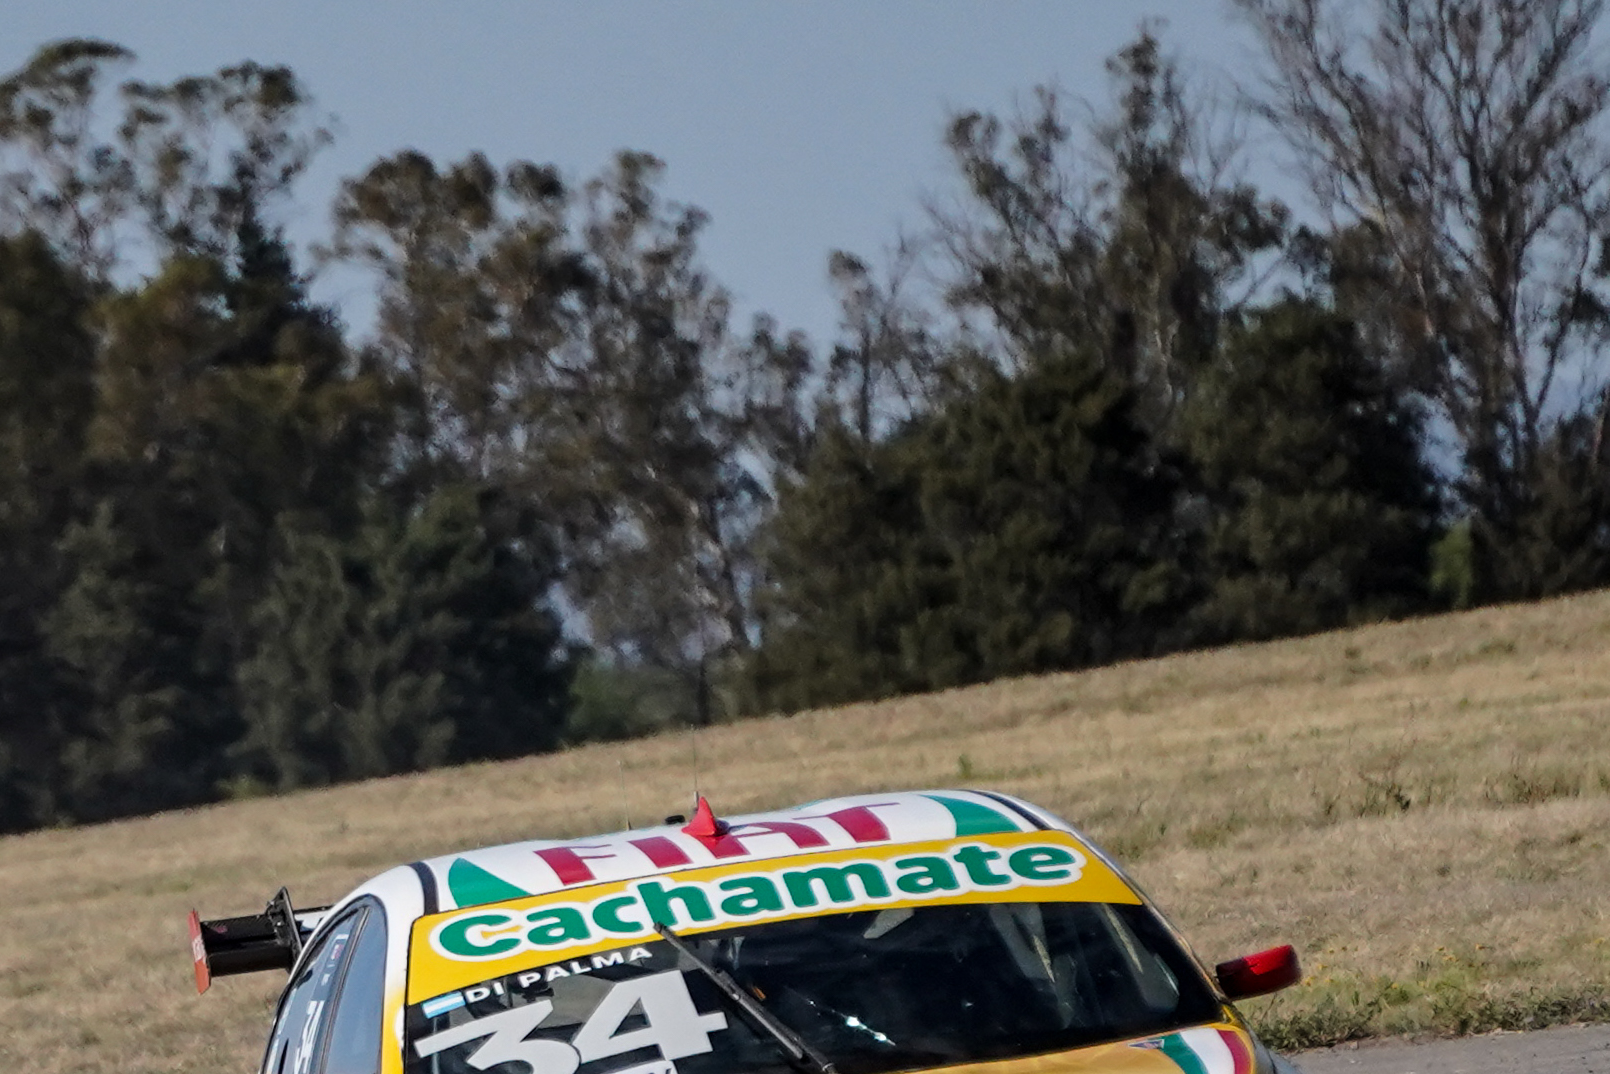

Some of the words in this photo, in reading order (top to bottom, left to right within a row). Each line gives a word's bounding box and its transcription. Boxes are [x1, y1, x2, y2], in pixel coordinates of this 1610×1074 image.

[533, 803, 900, 885] FIAT
[436, 840, 1080, 960] Cachamate
[464, 982, 503, 1004] DI
[519, 946, 653, 989] PALMA
